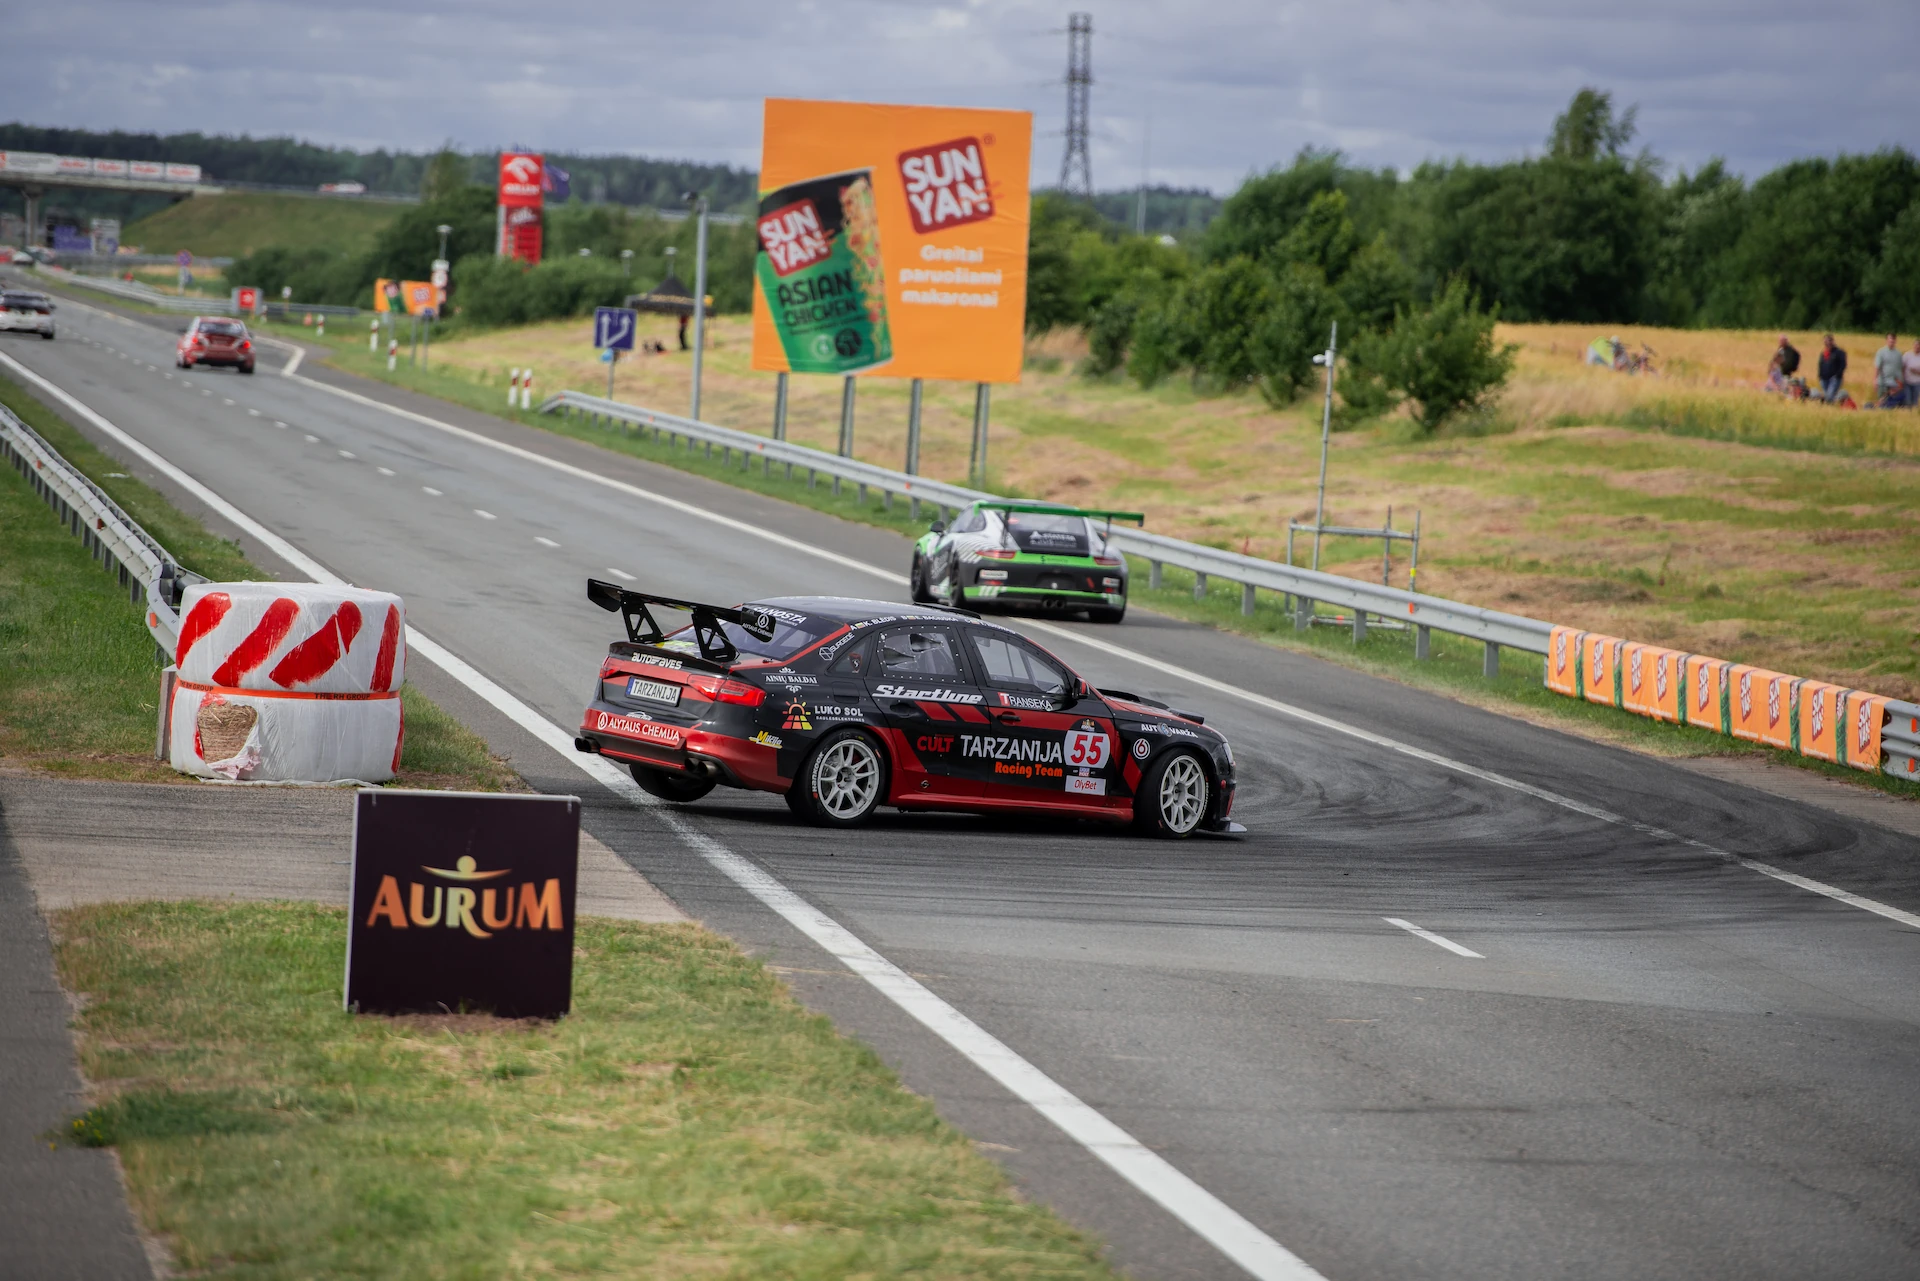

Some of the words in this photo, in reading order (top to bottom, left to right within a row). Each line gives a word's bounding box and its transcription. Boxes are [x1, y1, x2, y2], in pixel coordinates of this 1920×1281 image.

[902, 144, 982, 193] SUN
[761, 205, 818, 247] SUN
[778, 269, 853, 308] ASIAN
[783, 296, 857, 327] CHICKEN
[633, 681, 677, 701] TARZANIJA
[788, 676, 818, 684] BALDAI
[871, 684, 984, 704] Startline
[814, 705, 841, 715] LUKO
[844, 707, 864, 716] SOL
[608, 717, 641, 734] ALYTAUS
[641, 723, 681, 742] CHEMIJA
[916, 736, 955, 752] CULT
[960, 735, 1063, 763] TARZANIJA
[1070, 734, 1104, 765] 55
[995, 761, 1032, 778] Racing
[1035, 764, 1063, 777] Team
[1074, 779, 1097, 791] OlyBet
[366, 874, 564, 939] AURUM
